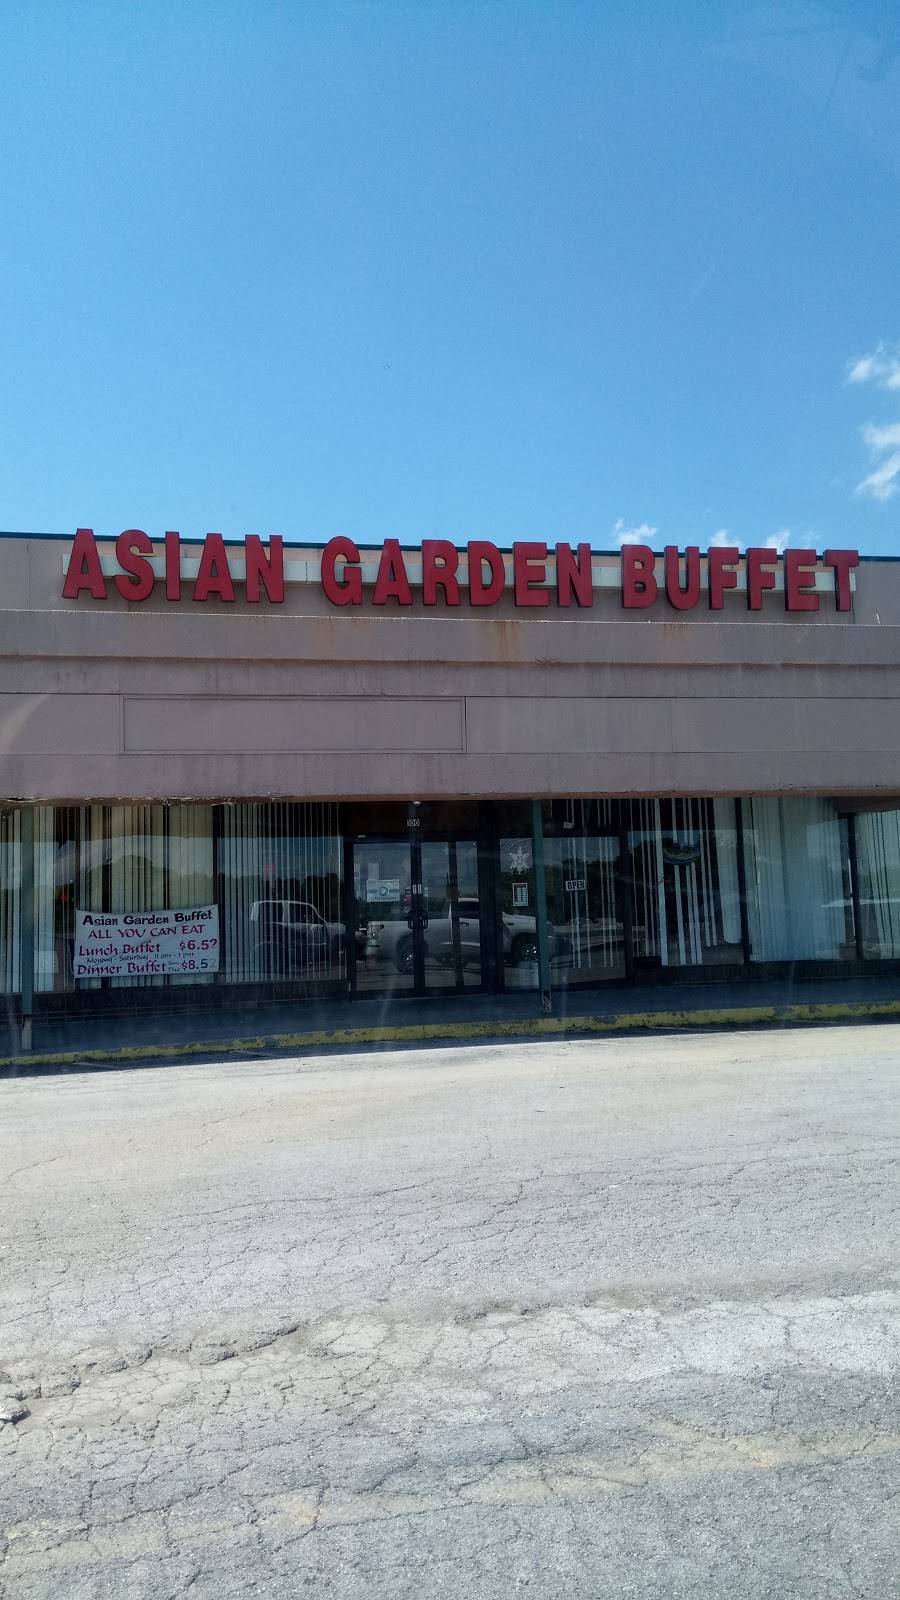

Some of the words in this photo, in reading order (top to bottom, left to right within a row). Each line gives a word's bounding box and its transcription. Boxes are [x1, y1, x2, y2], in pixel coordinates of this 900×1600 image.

[62, 528, 284, 603] ASIAN
[321, 536, 593, 607] GARDEN
[621, 544, 859, 611] BUFFET
[567, 880, 585, 890] OPEN
[82, 915, 118, 926] Asian
[123, 914, 169, 925] Garden
[174, 910, 212, 923] Buffet
[88, 929, 112, 939] ALL
[118, 928, 145, 938] YOU
[150, 926, 177, 937] CAN
[182, 924, 205, 935] EAT
[79, 943, 118, 956] Lunch
[122, 940, 160, 953] Buffet
[78, 964, 122, 976] Dinner
[128, 960, 166, 973] Buffet
